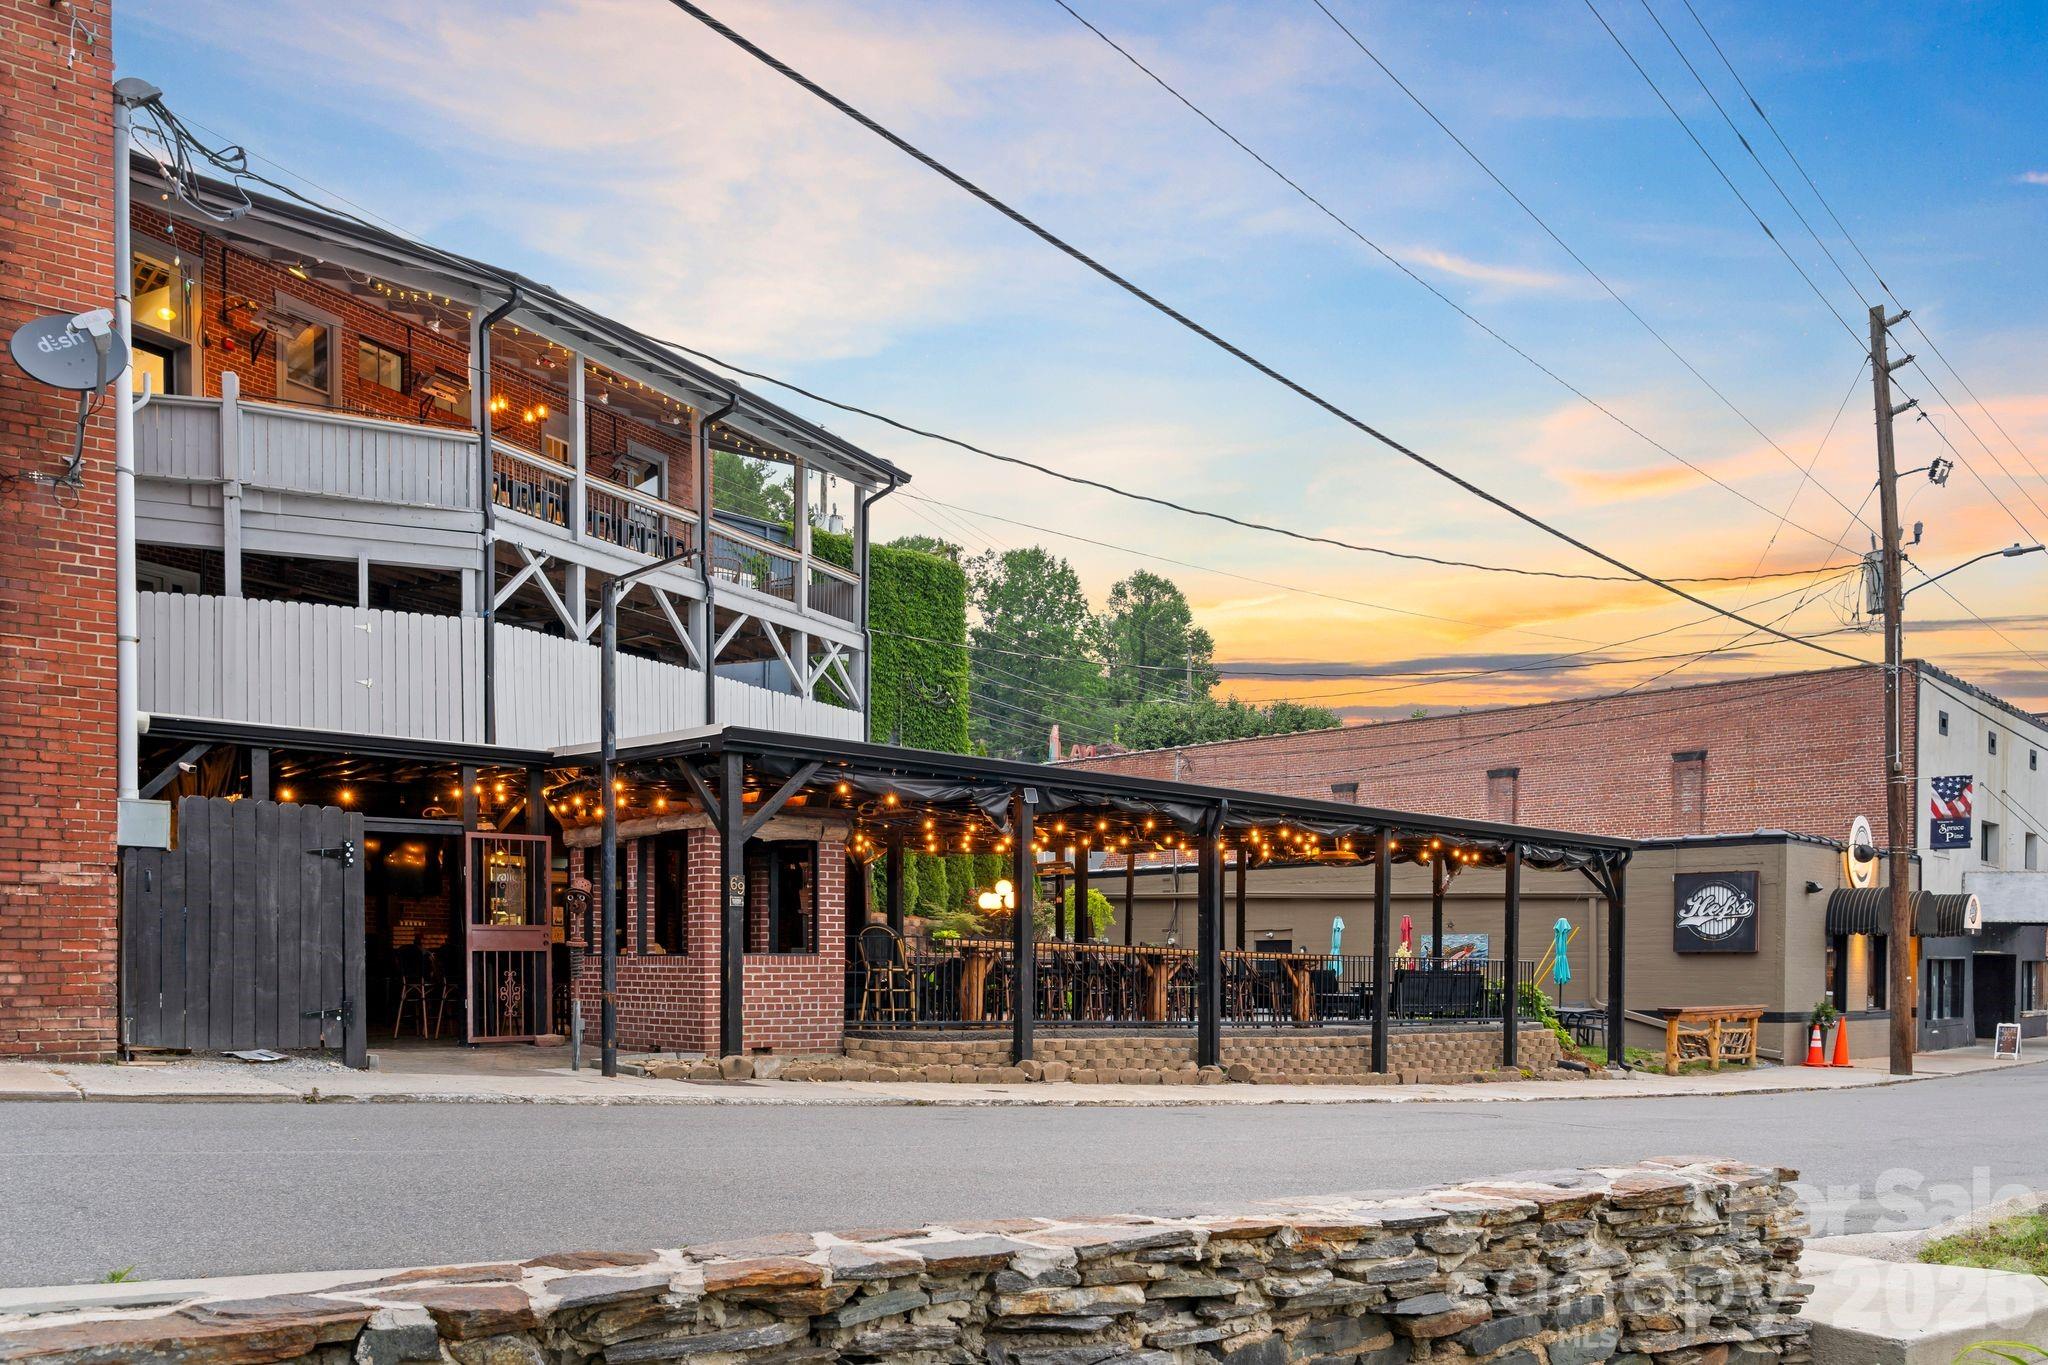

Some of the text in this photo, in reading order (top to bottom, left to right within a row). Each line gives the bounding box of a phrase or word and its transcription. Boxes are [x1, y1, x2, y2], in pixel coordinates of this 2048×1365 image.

[37, 328, 86, 353] dish
[1938, 824, 1964, 834] Spruce
[1945, 832, 1964, 842] Pine
[730, 876, 745, 895] 69
